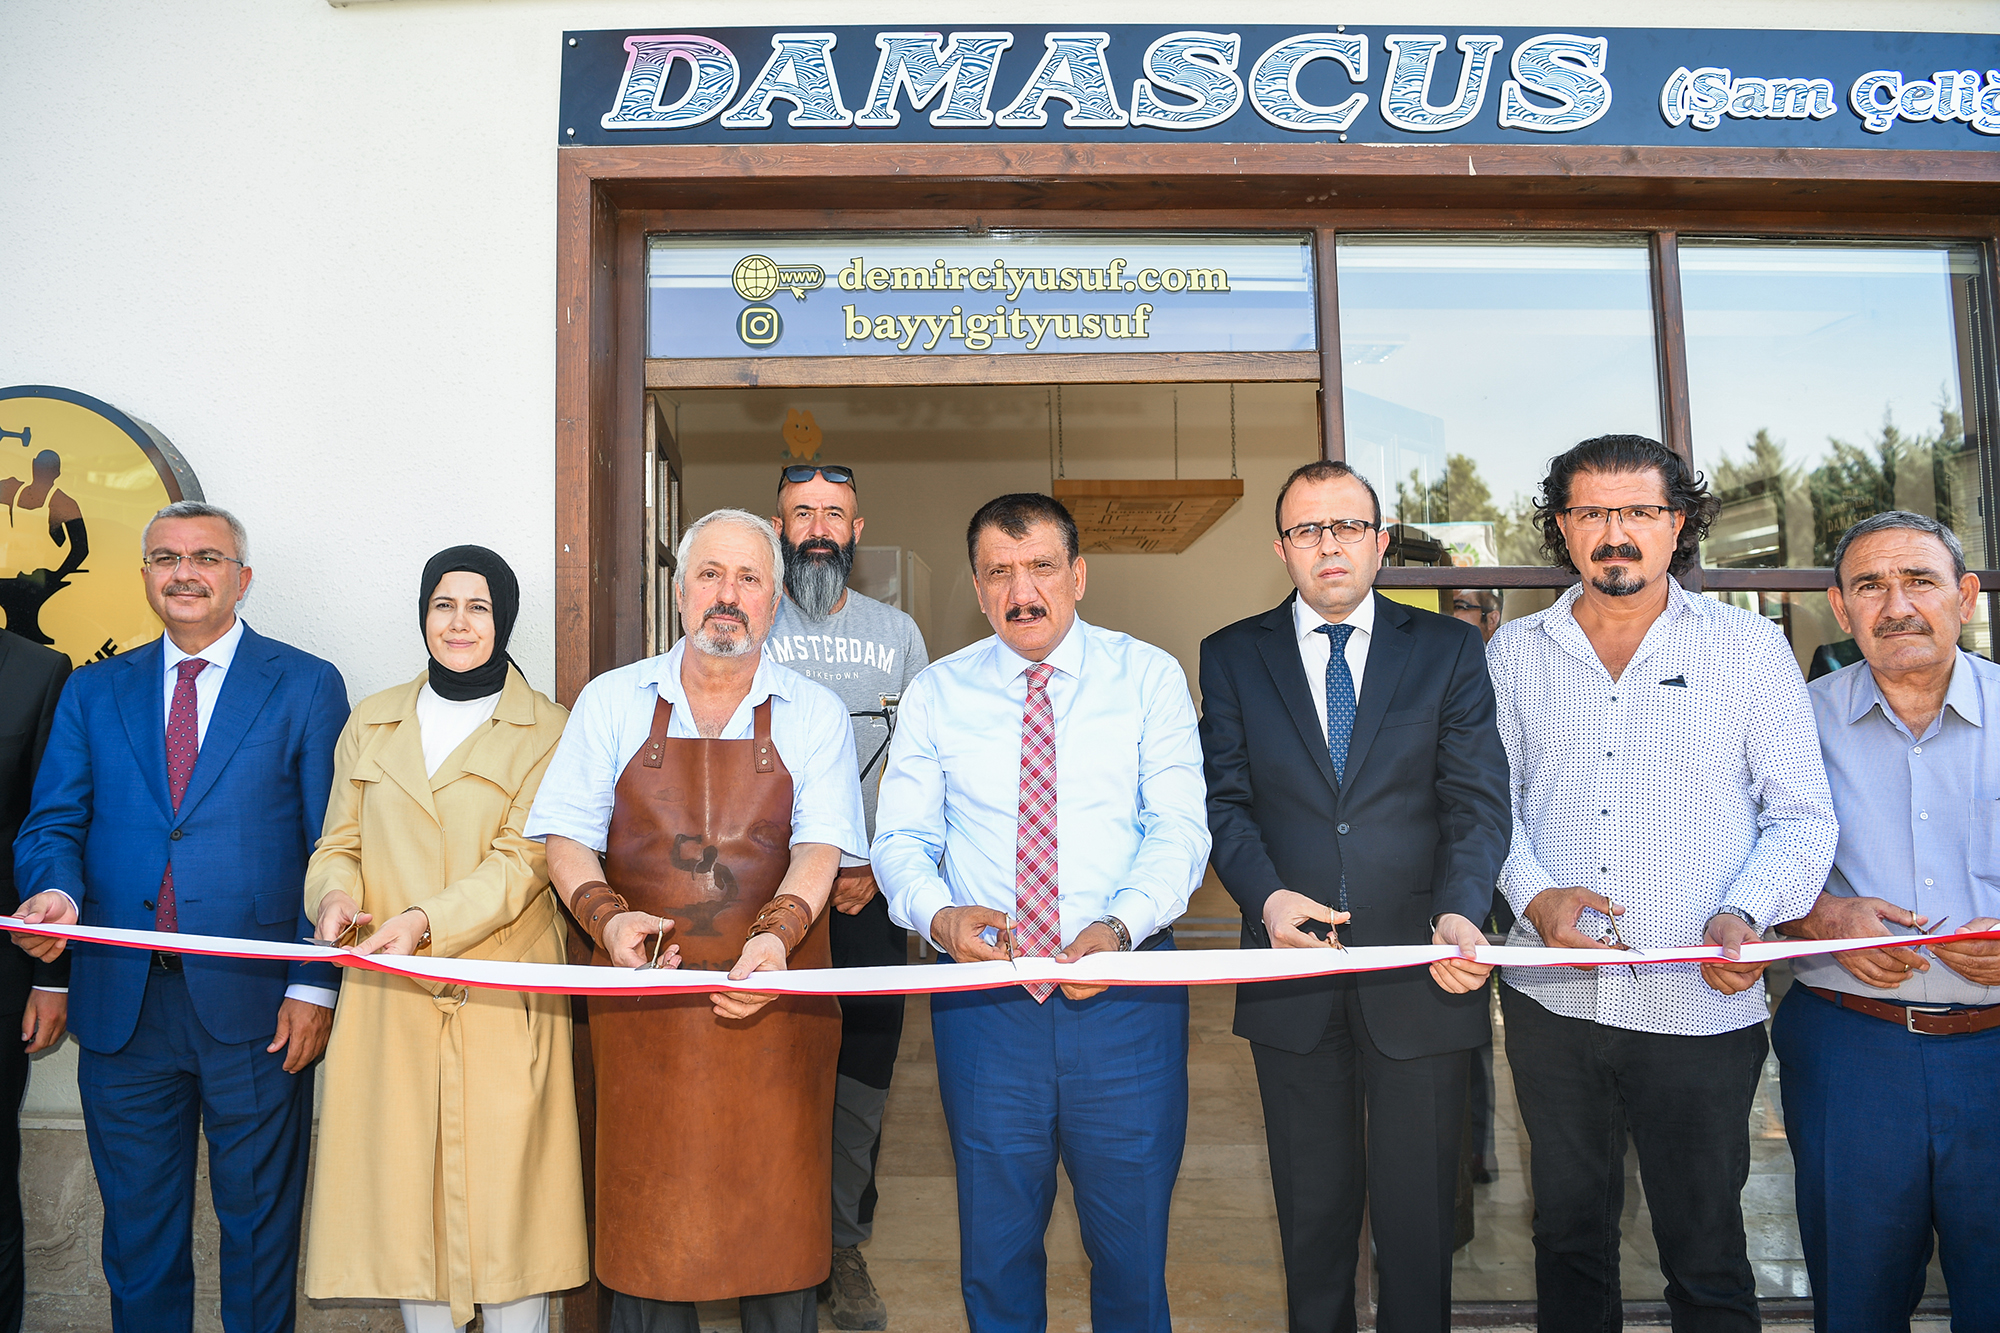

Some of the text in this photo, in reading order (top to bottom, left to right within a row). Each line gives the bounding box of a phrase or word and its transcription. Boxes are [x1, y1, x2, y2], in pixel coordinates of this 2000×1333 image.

[601, 32, 1612, 131] DAMASCUS
[1659, 67, 1838, 130] (Şam
[837, 256, 1231, 302] demirciyusuf.com
[842, 303, 1153, 351] bayyigityusuf
[805, 669, 859, 681] BIKETOWN
